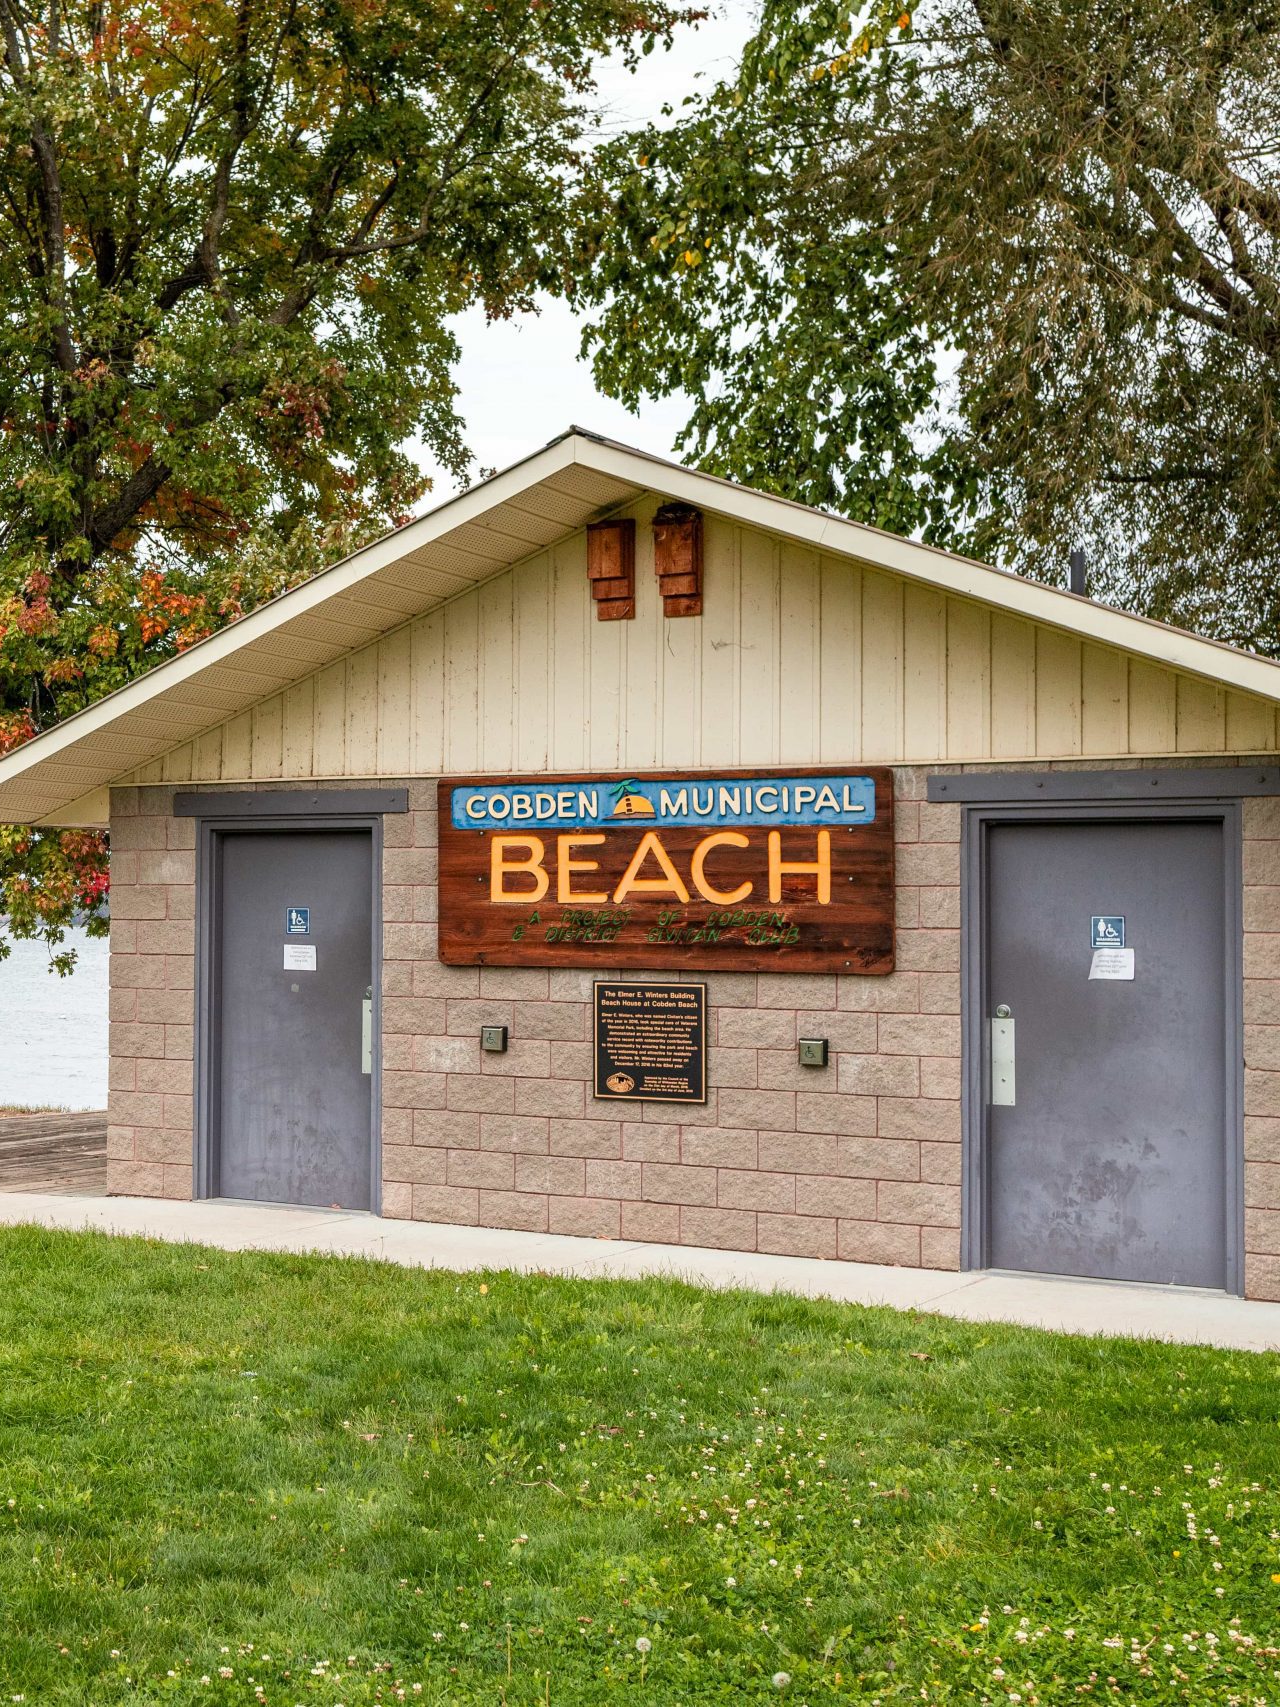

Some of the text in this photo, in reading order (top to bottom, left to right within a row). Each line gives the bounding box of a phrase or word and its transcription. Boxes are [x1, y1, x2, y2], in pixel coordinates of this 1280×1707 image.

[466, 785, 865, 819] COBDEN MUNICIPAL
[490, 831, 831, 905] BEACH
[528, 909, 785, 926] A PROJECT OF COBDEN
[512, 925, 800, 944] & DISTRICT CIVITAN CLUB
[670, 992, 695, 1000] Building
